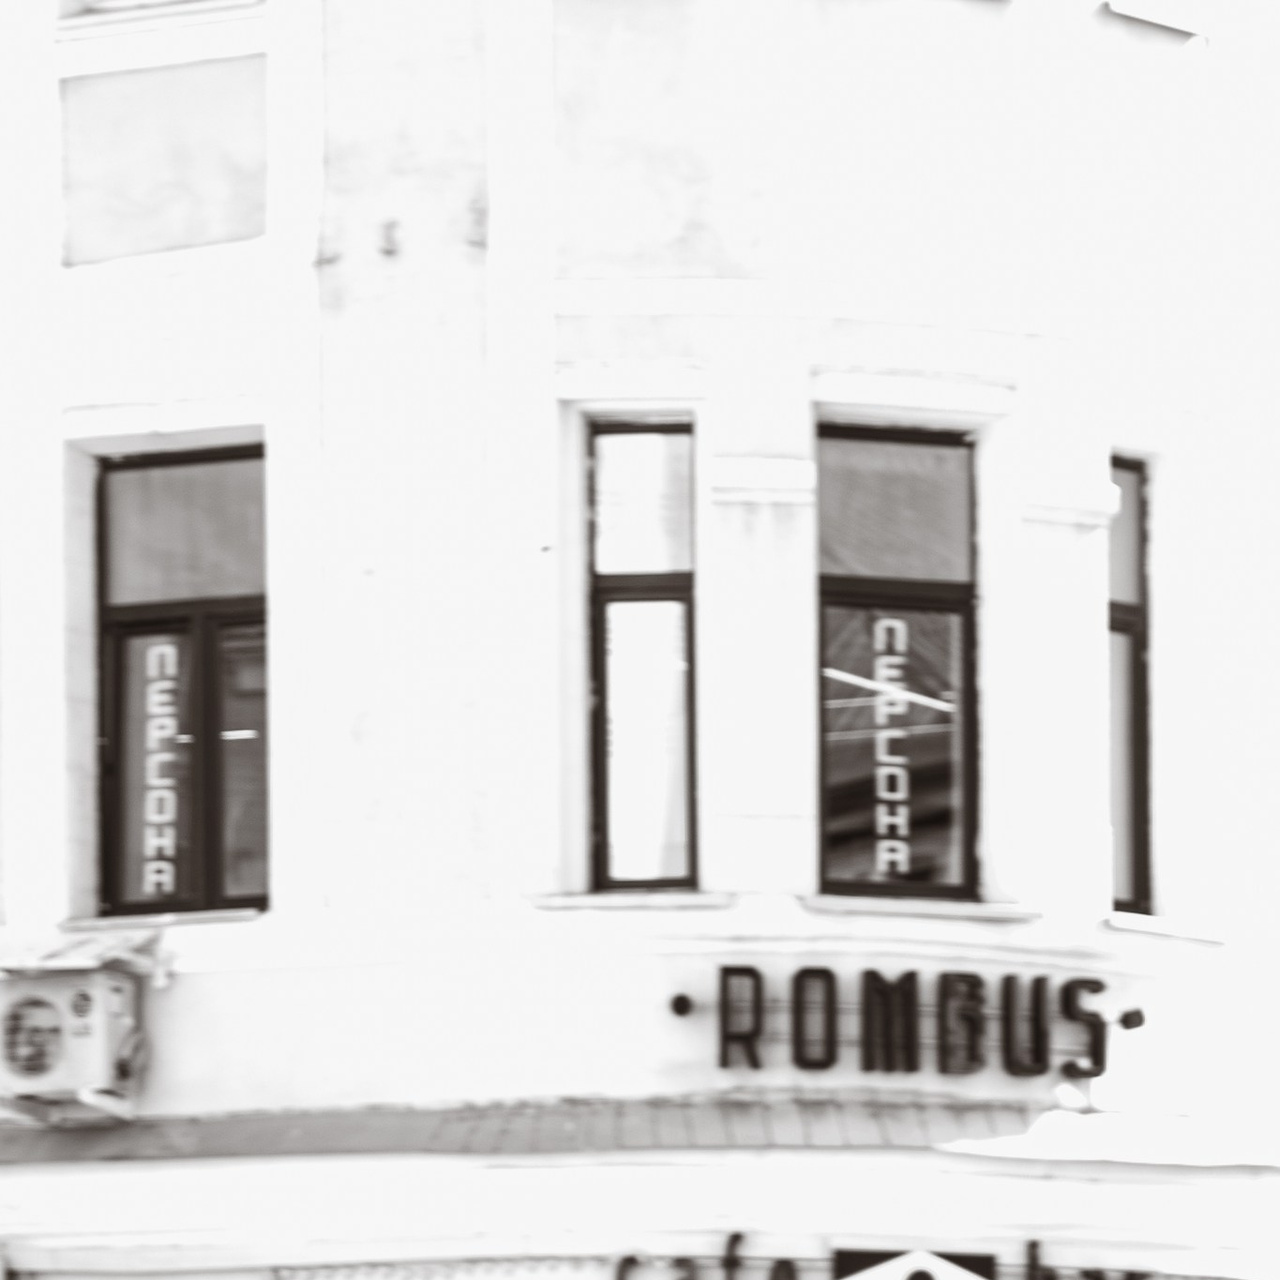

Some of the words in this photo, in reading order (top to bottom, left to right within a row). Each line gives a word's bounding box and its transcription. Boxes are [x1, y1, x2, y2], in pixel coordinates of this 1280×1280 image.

[145, 643, 178, 894] ПЕРСОНА
[873, 617, 911, 875] ПЕРСОНА
[717, 965, 1108, 1079] ROMBUS
